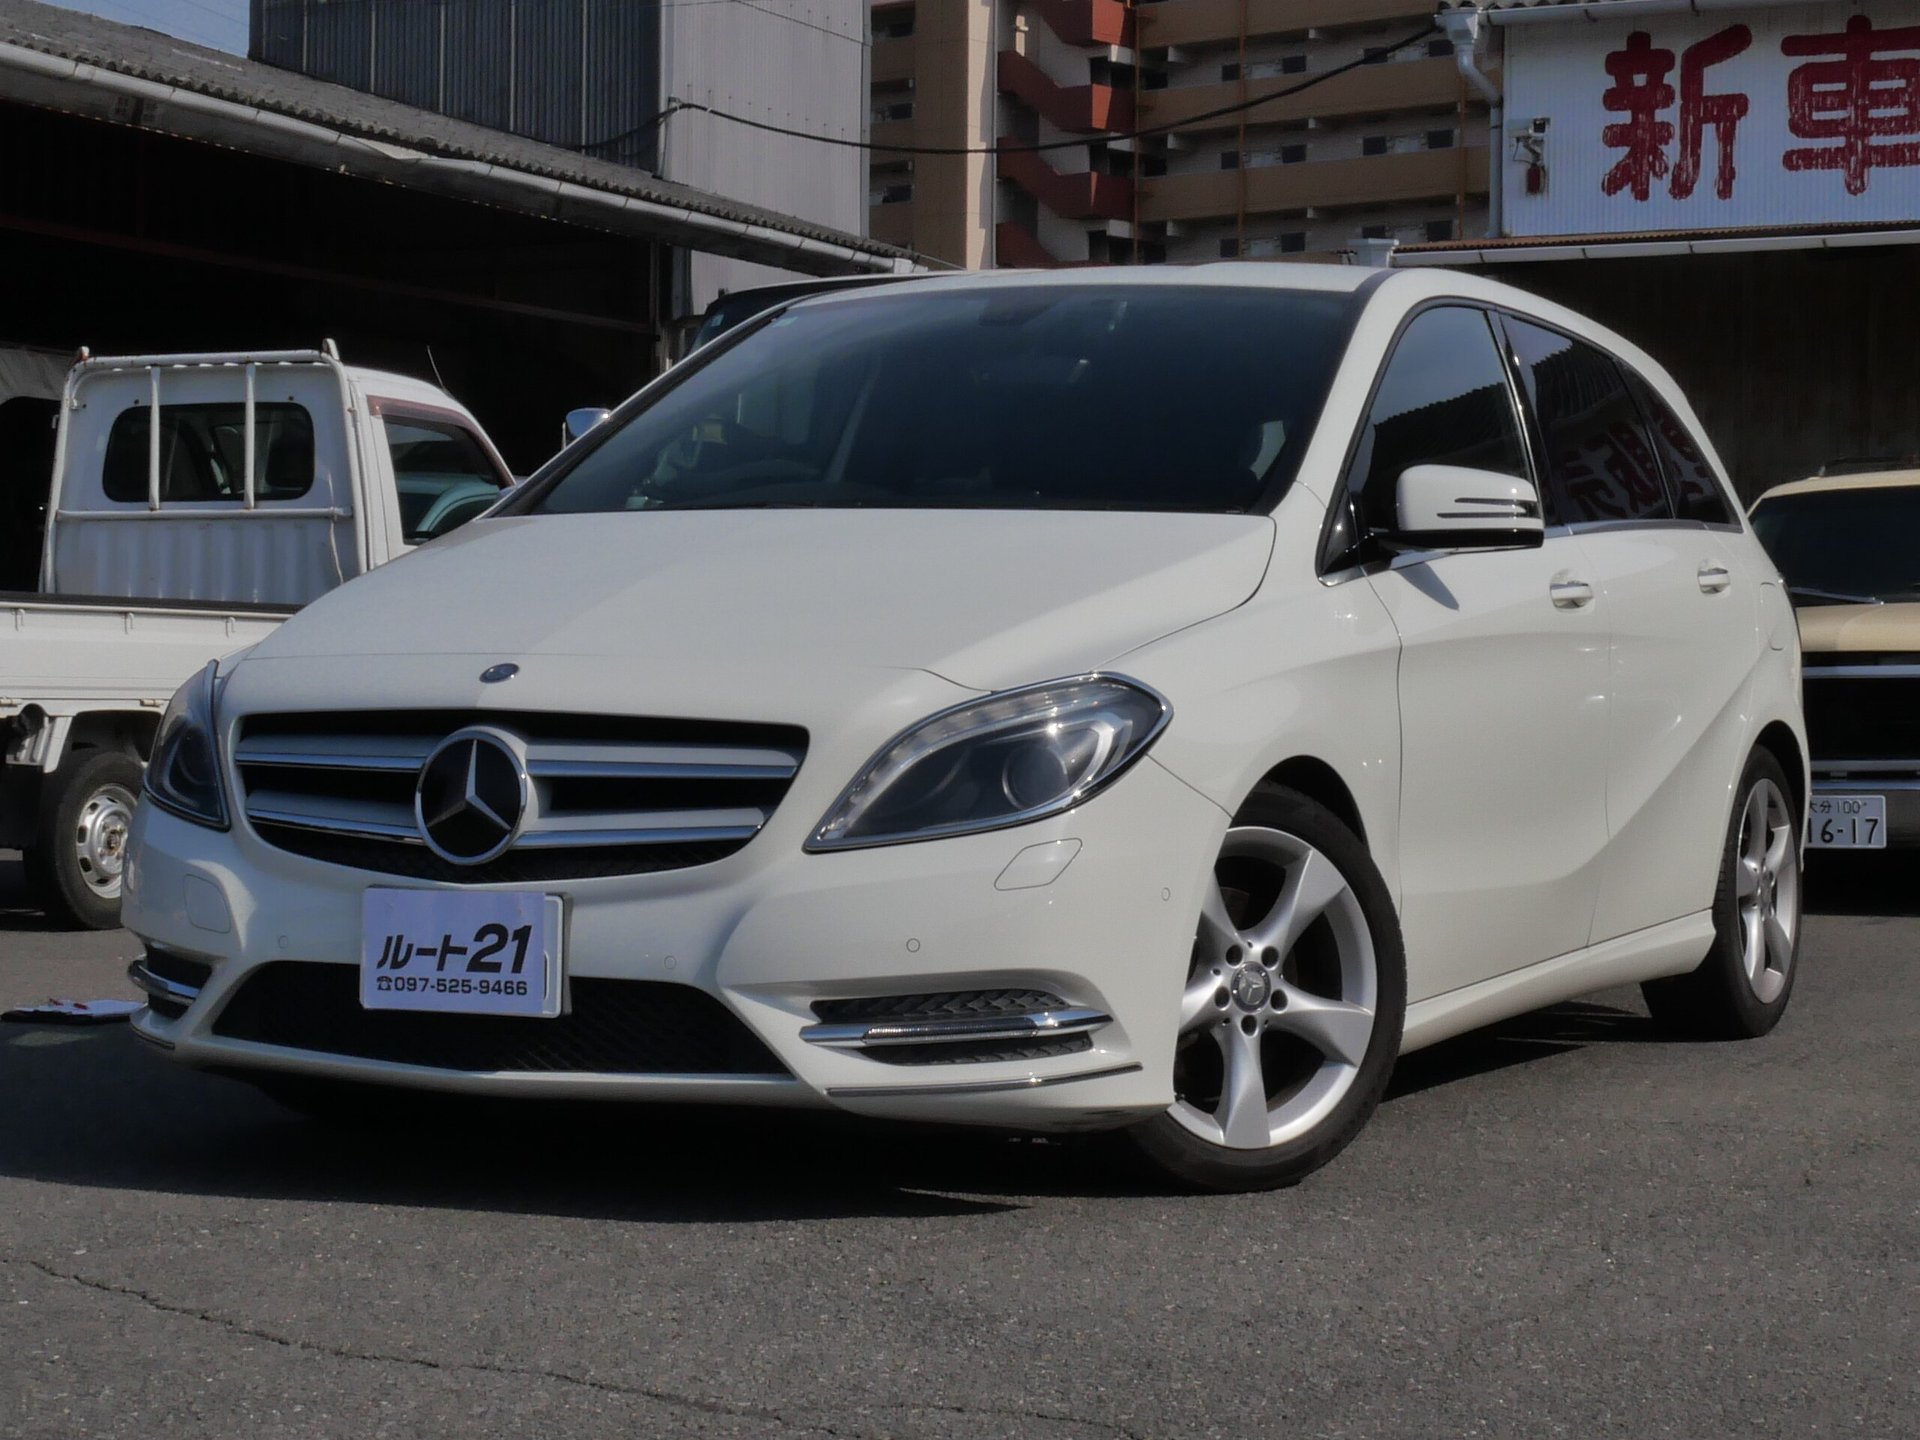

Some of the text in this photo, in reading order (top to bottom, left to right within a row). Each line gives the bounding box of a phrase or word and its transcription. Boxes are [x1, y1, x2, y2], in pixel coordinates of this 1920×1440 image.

[1601, 15, 1920, 201] 新車
[1836, 800, 1861, 814] 100
[1807, 818, 1878, 844] 16-17
[377, 923, 532, 973] ルート21
[394, 977, 528, 996] 097-525-9466
